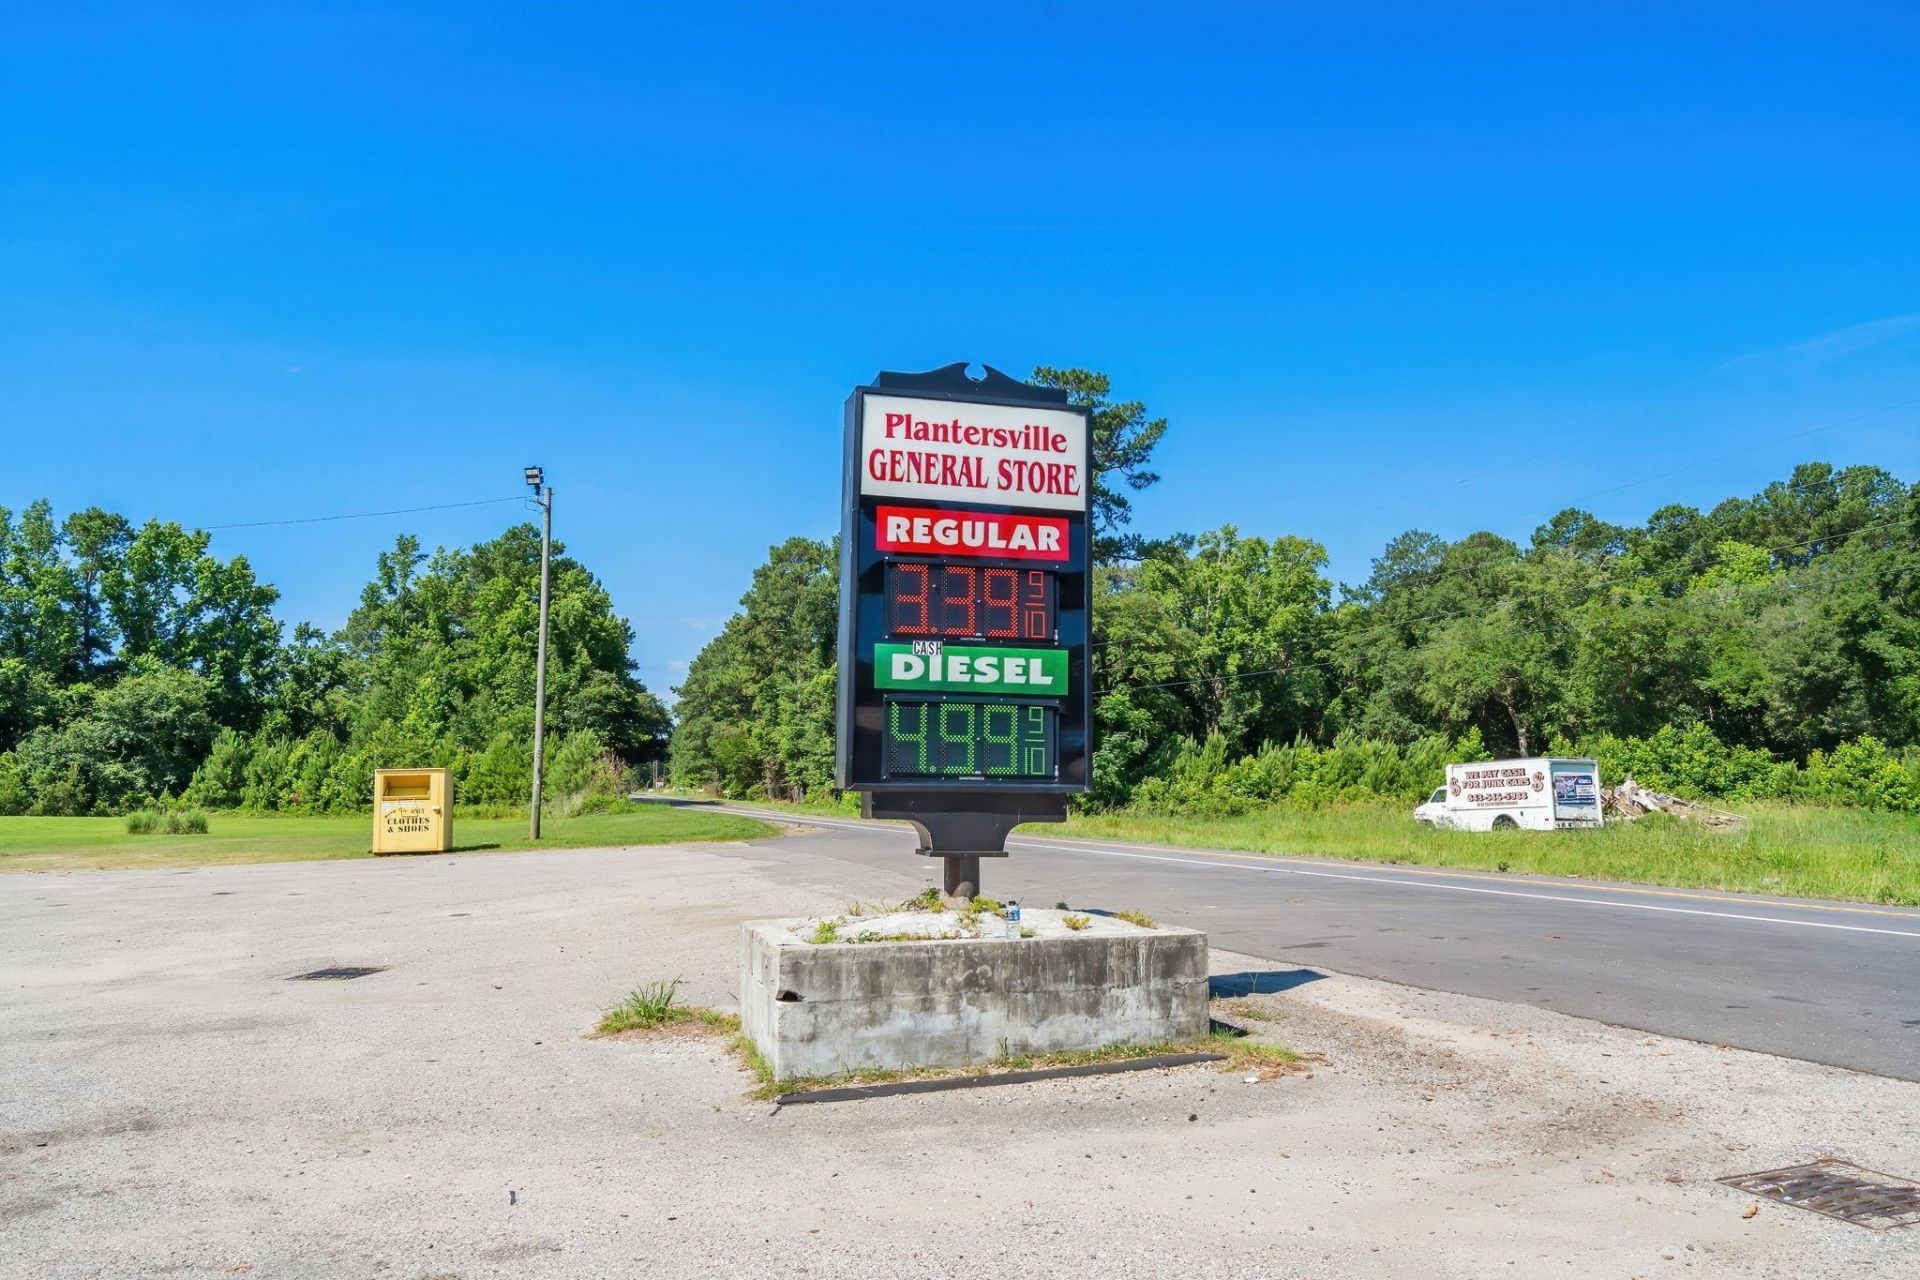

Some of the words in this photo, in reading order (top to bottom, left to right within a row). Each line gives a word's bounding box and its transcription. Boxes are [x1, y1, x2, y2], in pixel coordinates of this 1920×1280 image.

[884, 412, 1068, 453] Plantersville
[868, 448, 990, 489] GENERAL
[997, 458, 1081, 496] STORE
[886, 515, 1061, 551] REGULAR
[913, 641, 943, 655] CASH
[891, 653, 1054, 685] DIESEL
[1462, 781, 1480, 789] FOR
[1481, 779, 1505, 789] JUNK
[1505, 777, 1531, 787] CARS
[1465, 771, 1480, 779] WE
[1481, 770, 1500, 778] PAY
[1501, 768, 1526, 777] CASH
